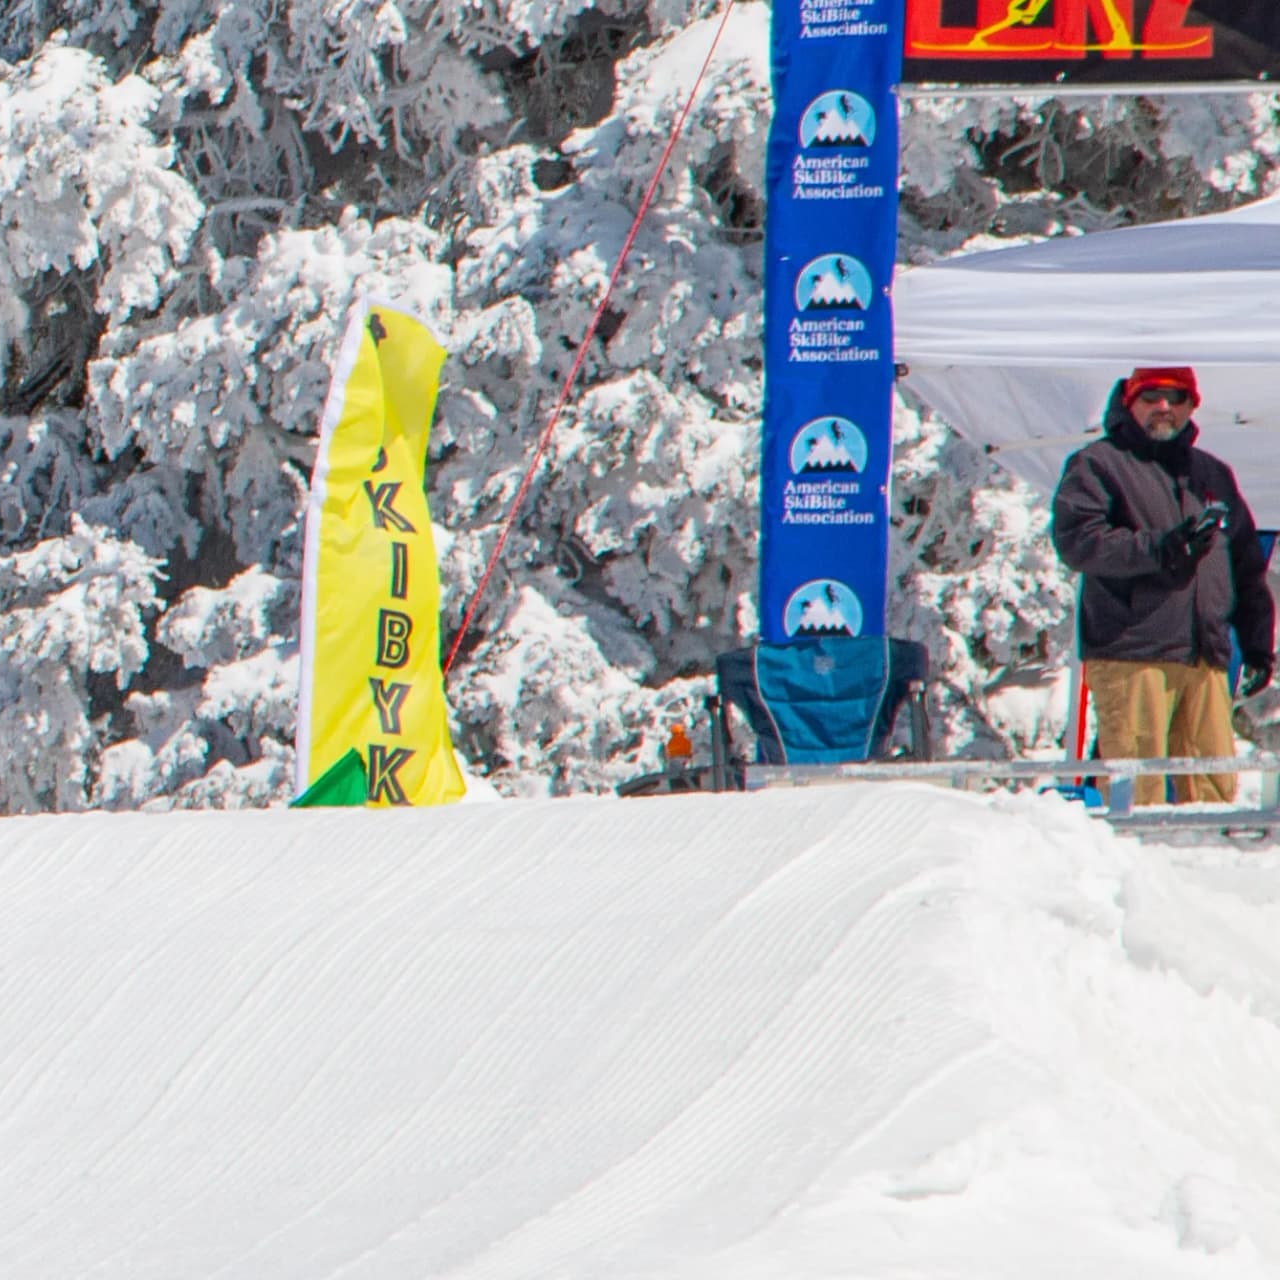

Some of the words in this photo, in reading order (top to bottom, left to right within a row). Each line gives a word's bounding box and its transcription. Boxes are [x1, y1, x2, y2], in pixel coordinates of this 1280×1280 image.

[801, 8, 860, 24] SkiBike
[800, 21, 888, 38] Association
[793, 154, 869, 169] American
[794, 169, 856, 184] SkiBike
[793, 183, 883, 199] Association
[789, 317, 864, 332] American
[790, 331, 851, 347] SkiBike
[789, 346, 879, 362] Association
[784, 480, 860, 495] American
[785, 494, 846, 509] SkiBike
[782, 509, 875, 524] Association
[364, 447, 418, 806] KIBYK
